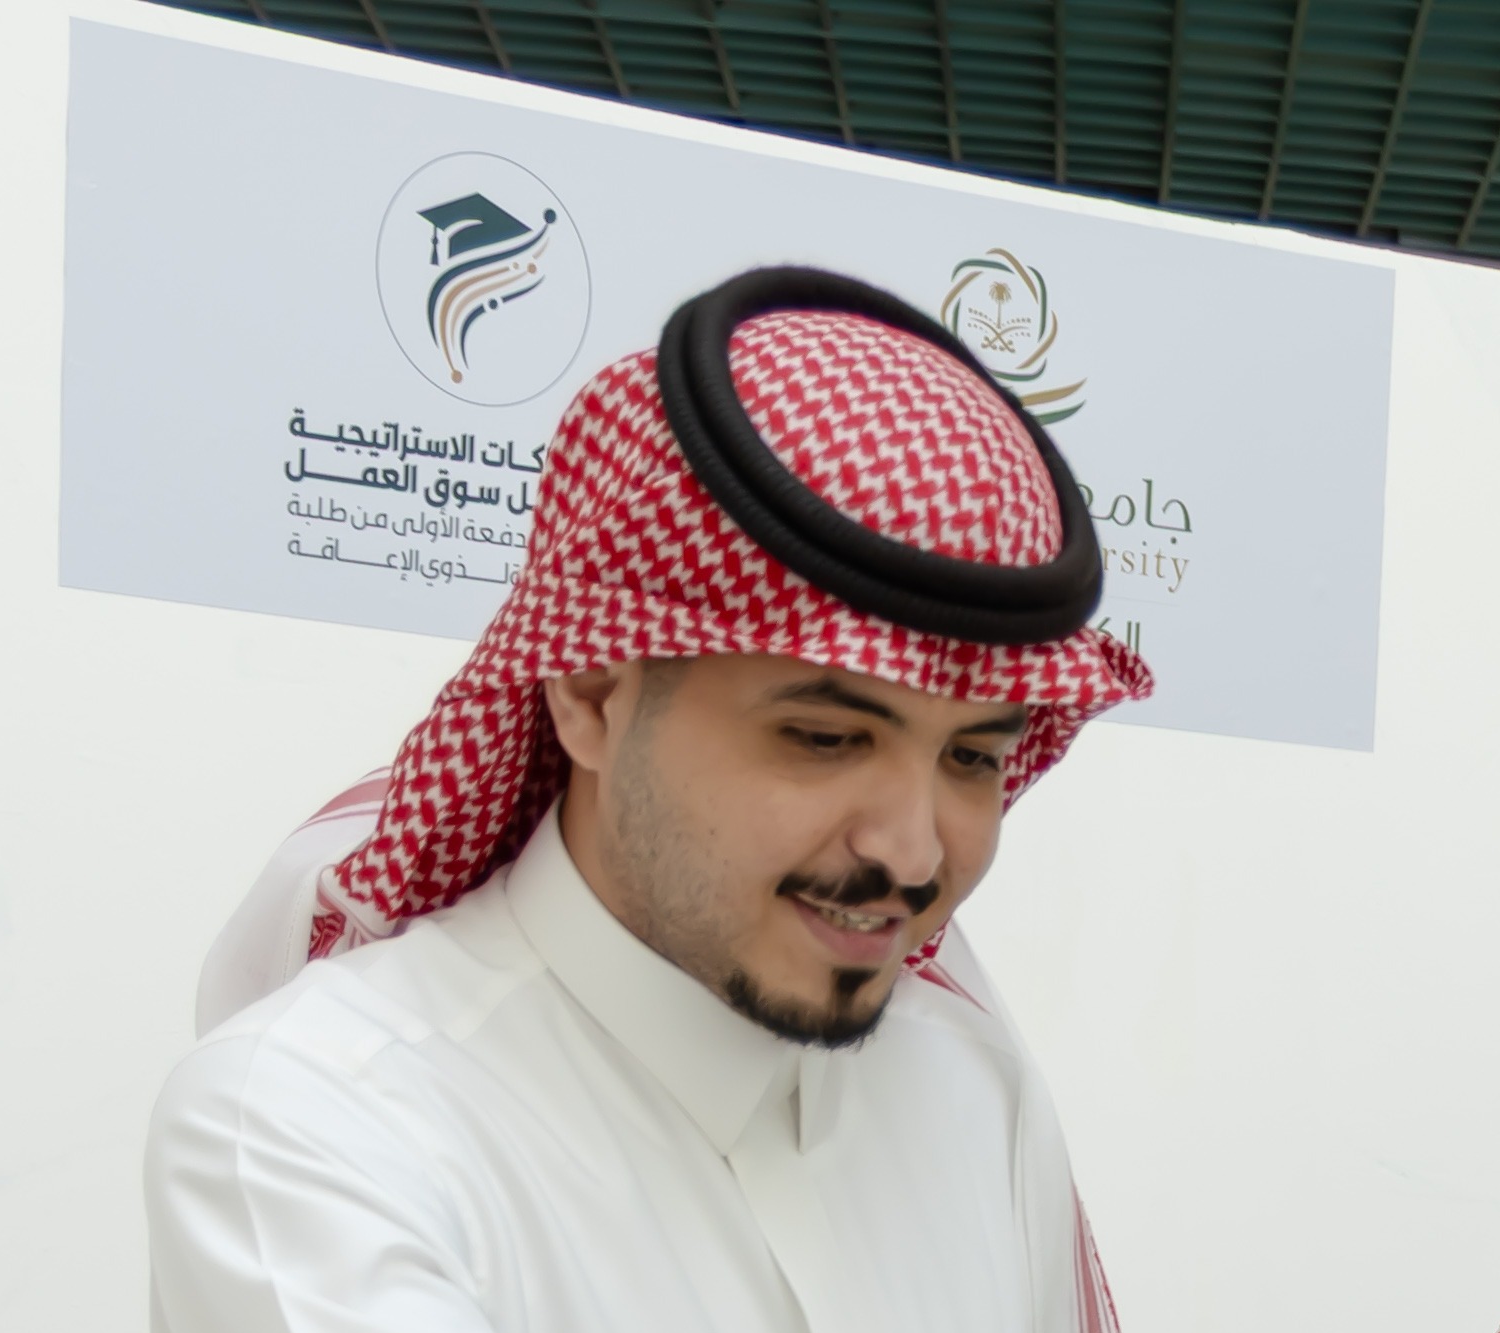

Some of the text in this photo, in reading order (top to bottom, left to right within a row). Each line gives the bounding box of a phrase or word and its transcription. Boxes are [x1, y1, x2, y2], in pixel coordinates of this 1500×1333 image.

[288, 407, 475, 463] الاستراتيجية
[284, 447, 417, 493] العمل
[424, 468, 500, 508] سوق
[287, 492, 527, 549] دفعة الأولى من طلبة
[1077, 477, 1192, 545] جام
[287, 531, 420, 582] الإعاقة
[1102, 541, 1190, 593] rsity
